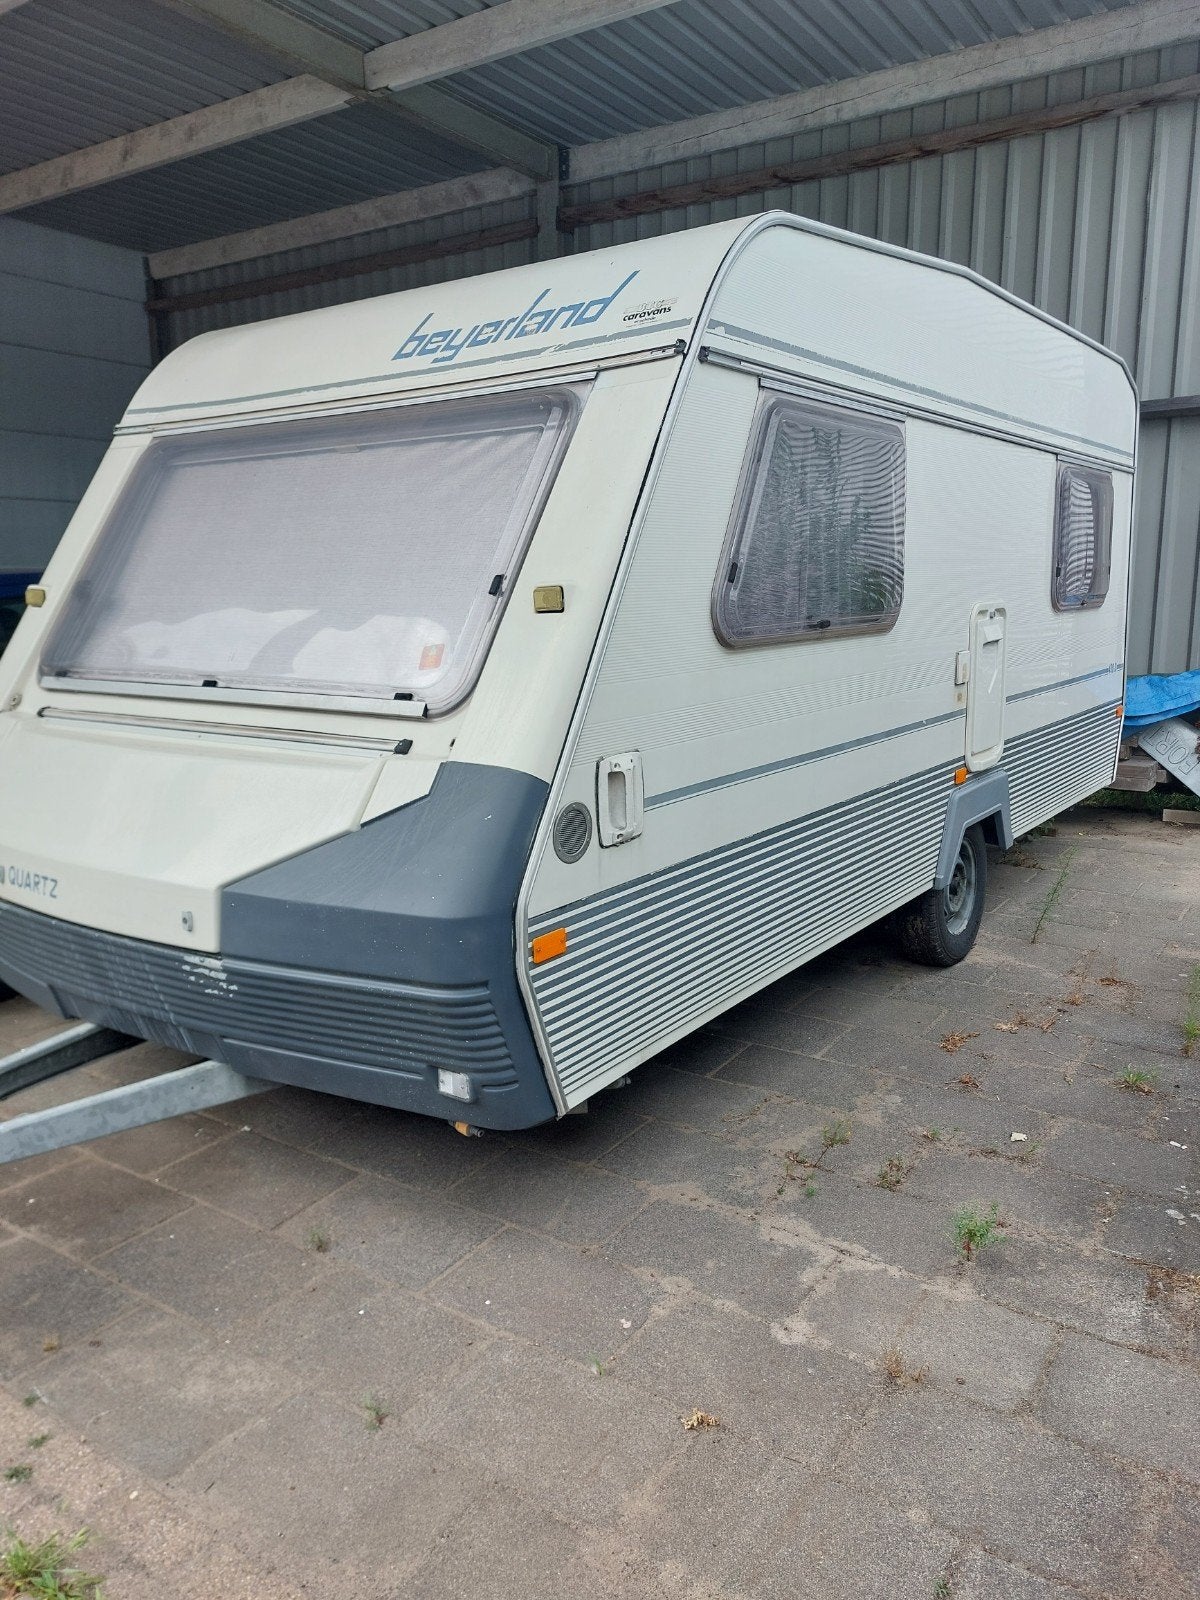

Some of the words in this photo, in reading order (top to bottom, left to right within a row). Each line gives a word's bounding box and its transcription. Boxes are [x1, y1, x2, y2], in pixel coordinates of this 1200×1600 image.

[391, 270, 640, 364] beyerland
[623, 306, 672, 321] caravans
[8, 866, 58, 898] QUARTZ
